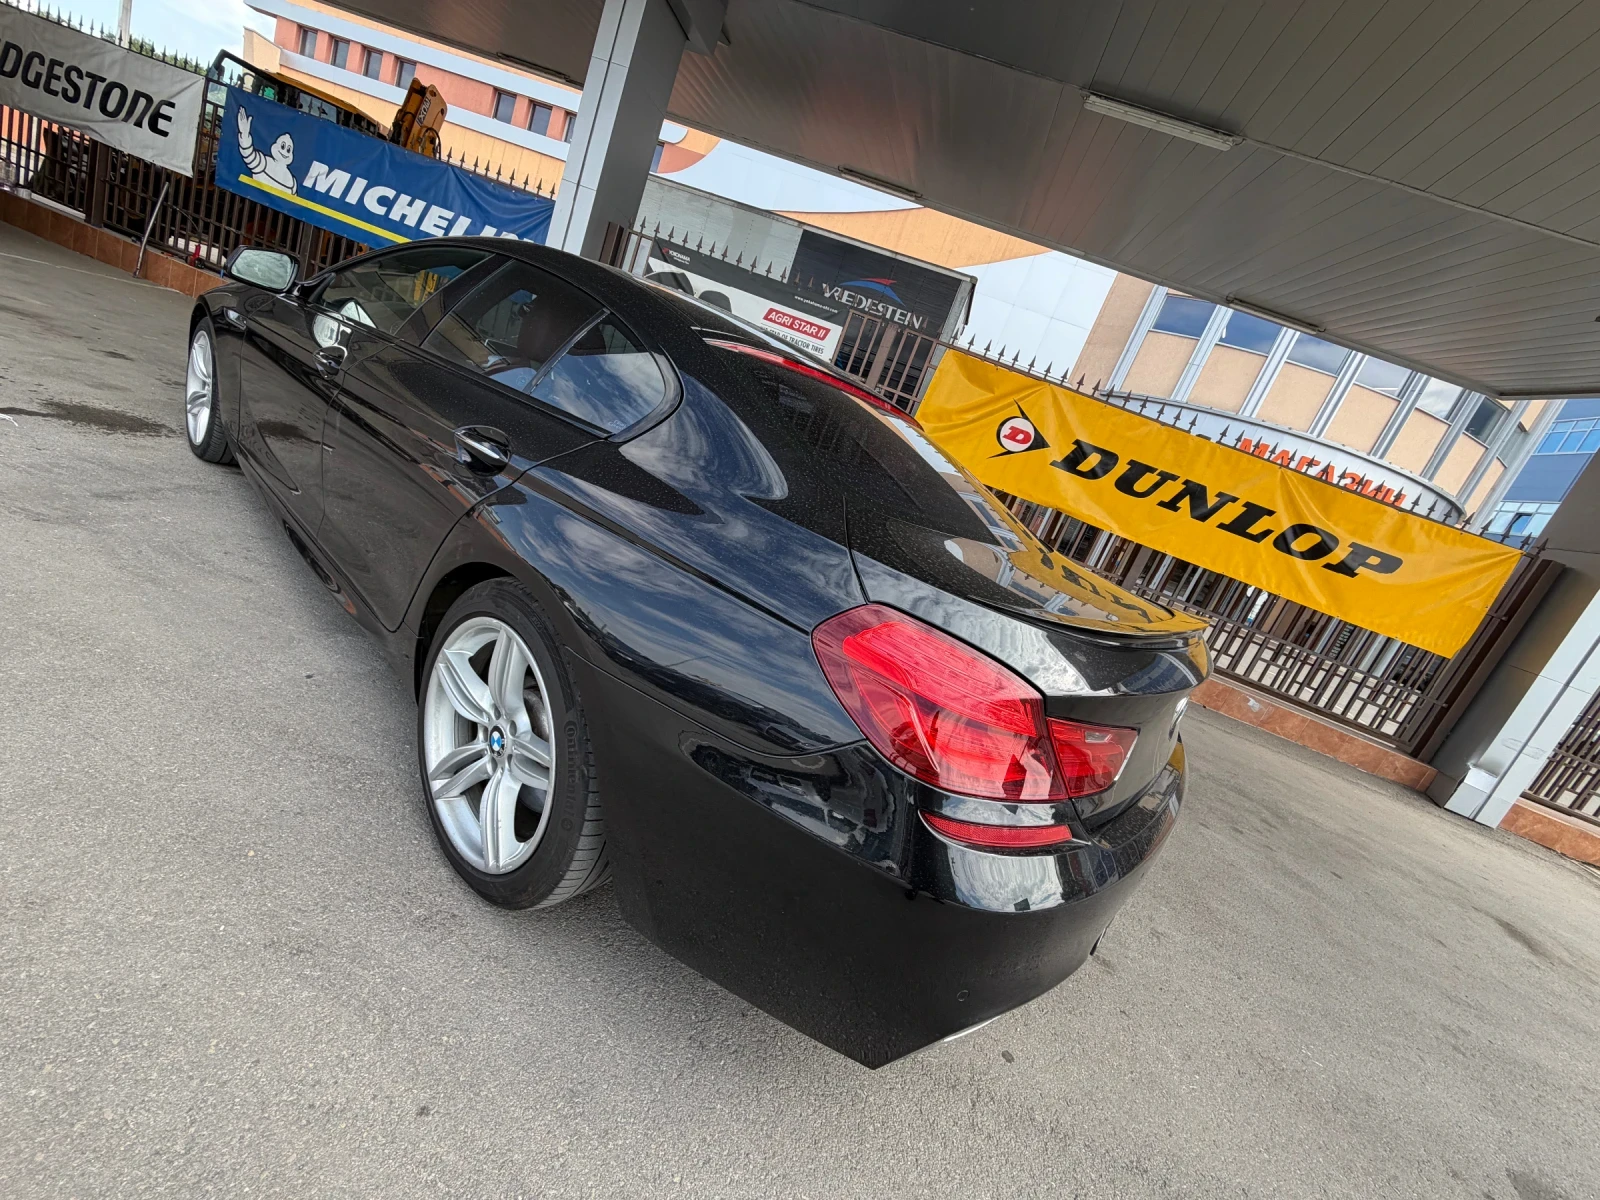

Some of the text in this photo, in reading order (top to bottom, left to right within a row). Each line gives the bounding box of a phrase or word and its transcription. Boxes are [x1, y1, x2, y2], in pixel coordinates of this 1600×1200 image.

[0, 38, 177, 138] DGESTONE
[303, 160, 535, 243] MICHEL
[767, 311, 793, 326] AGRI
[792, 320, 817, 336] STAR
[810, 344, 825, 355] TIRES
[1002, 425, 1032, 445] D
[1049, 438, 1403, 579] DUNLOP
